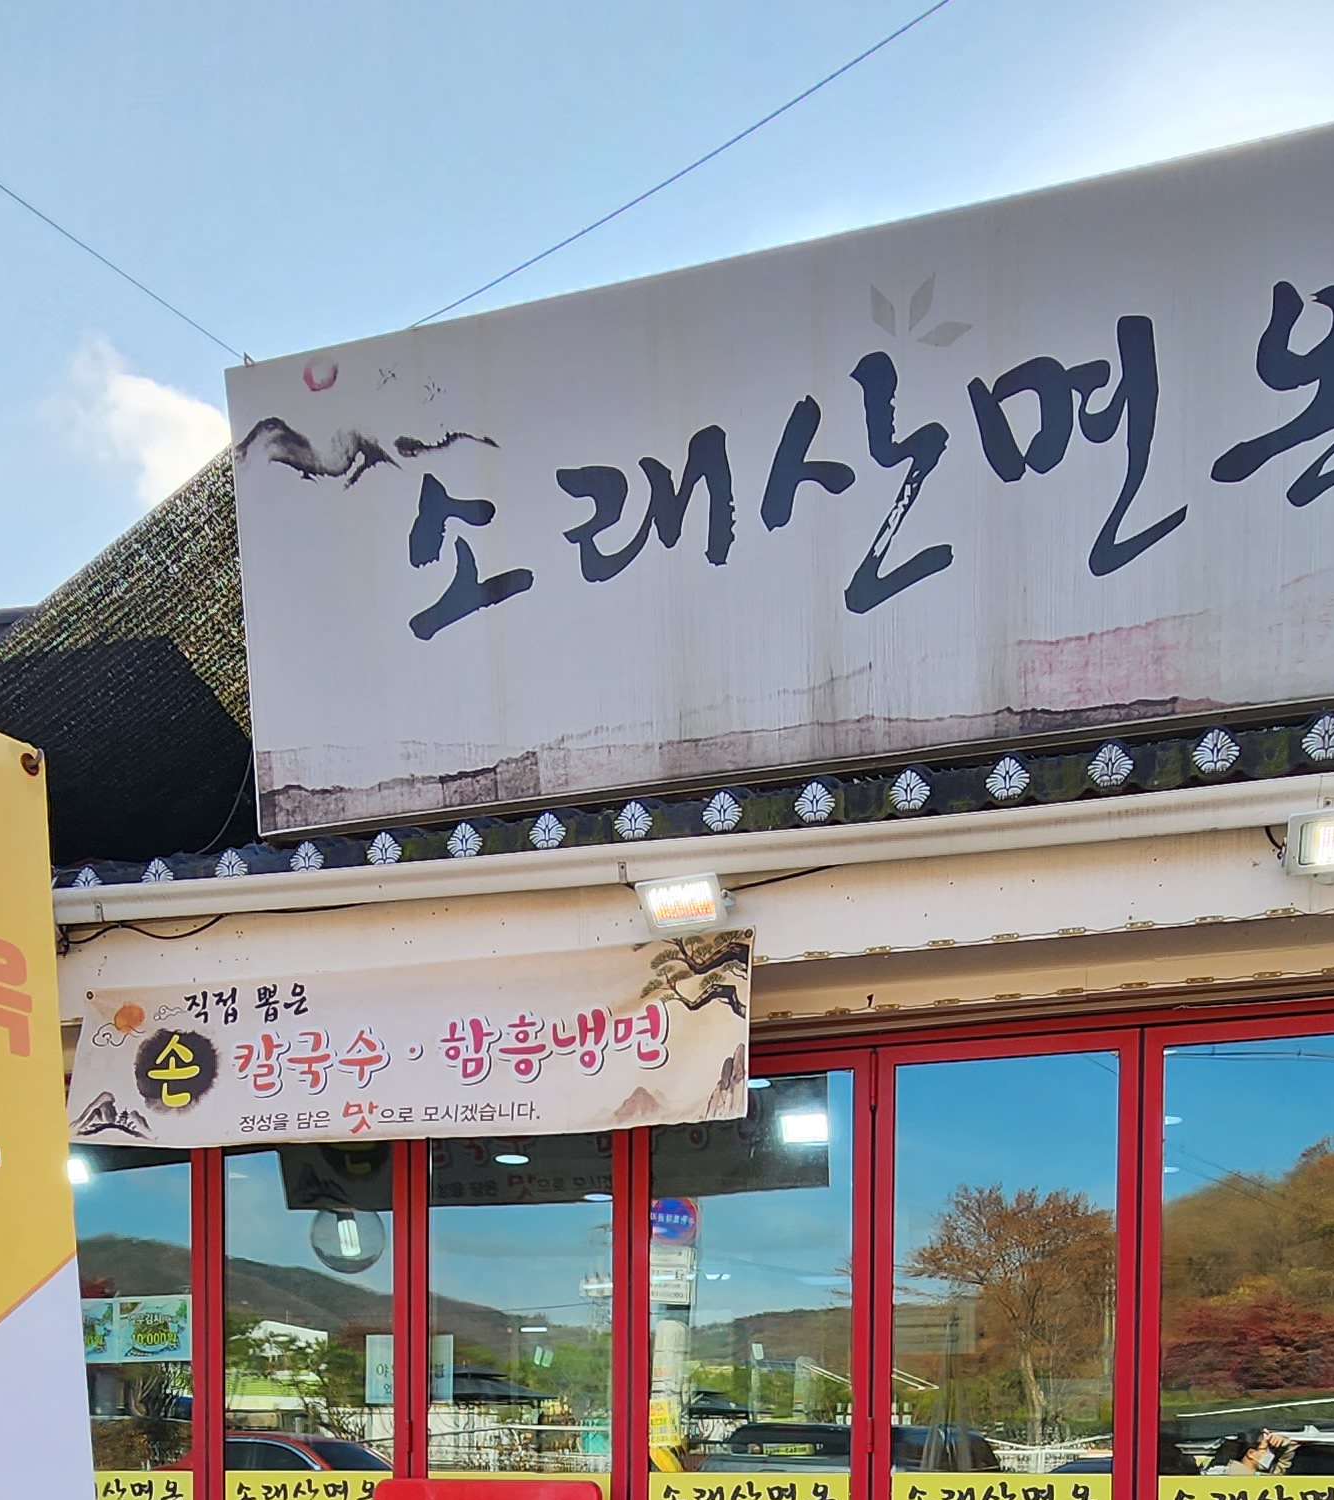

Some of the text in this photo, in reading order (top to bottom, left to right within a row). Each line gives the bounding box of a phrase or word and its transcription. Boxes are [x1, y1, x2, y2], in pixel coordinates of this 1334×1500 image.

[184, 982, 309, 1025] 직접 뽑은
[147, 1003, 662, 1108] 손 칼국수 함흥냉면
[239, 1101, 541, 1134] 정성을 담은 맛으로 모시겠습니다.
